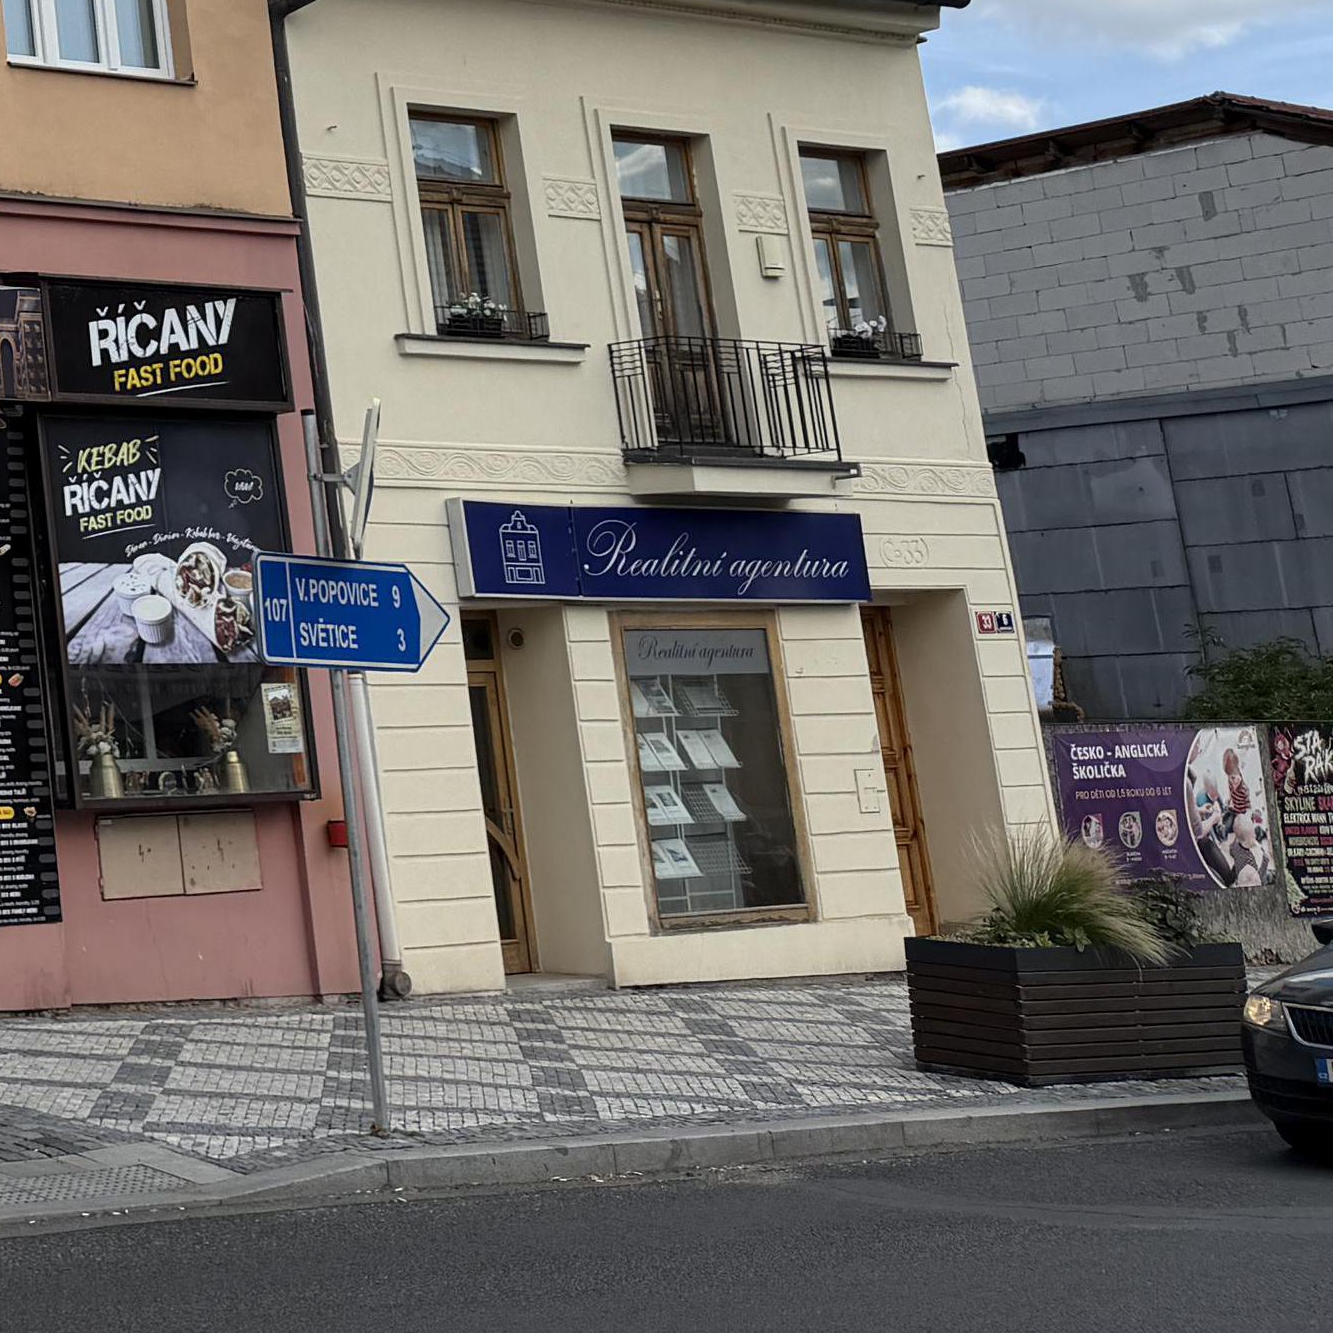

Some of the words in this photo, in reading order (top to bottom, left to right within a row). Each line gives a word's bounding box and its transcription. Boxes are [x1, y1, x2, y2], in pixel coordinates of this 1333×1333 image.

[88, 298, 238, 367] ŘÍČANY
[113, 365, 164, 392] FAST
[169, 352, 224, 382] FOOD
[77, 439, 141, 473] KEBAB
[63, 468, 161, 516] ŘÍČANY
[79, 513, 114, 532] FAST
[116, 505, 152, 525] FOOD
[583, 514, 728, 578] Realitní
[729, 546, 851, 595] agentura
[295, 578, 379, 607] V.POPOVICE
[392, 585, 401, 608] 9
[264, 597, 287, 623] 107
[982, 615, 992, 629] 33
[1002, 614, 1009, 626] 6
[300, 618, 359, 650] SVĚTICE
[397, 628, 406, 651] 3
[637, 635, 697, 661] Realitní
[699, 643, 755, 668] agentura
[1070, 743, 1104, 760] ČESKO
[1114, 740, 1169, 759] ANGLICKÁ
[1072, 761, 1127, 779] ŠKOLIČKA
[1075, 791, 1089, 800] PRO
[1105, 789, 1116, 798] OD
[1126, 788, 1145, 797] ROKU
[1162, 786, 1172, 796] LET
